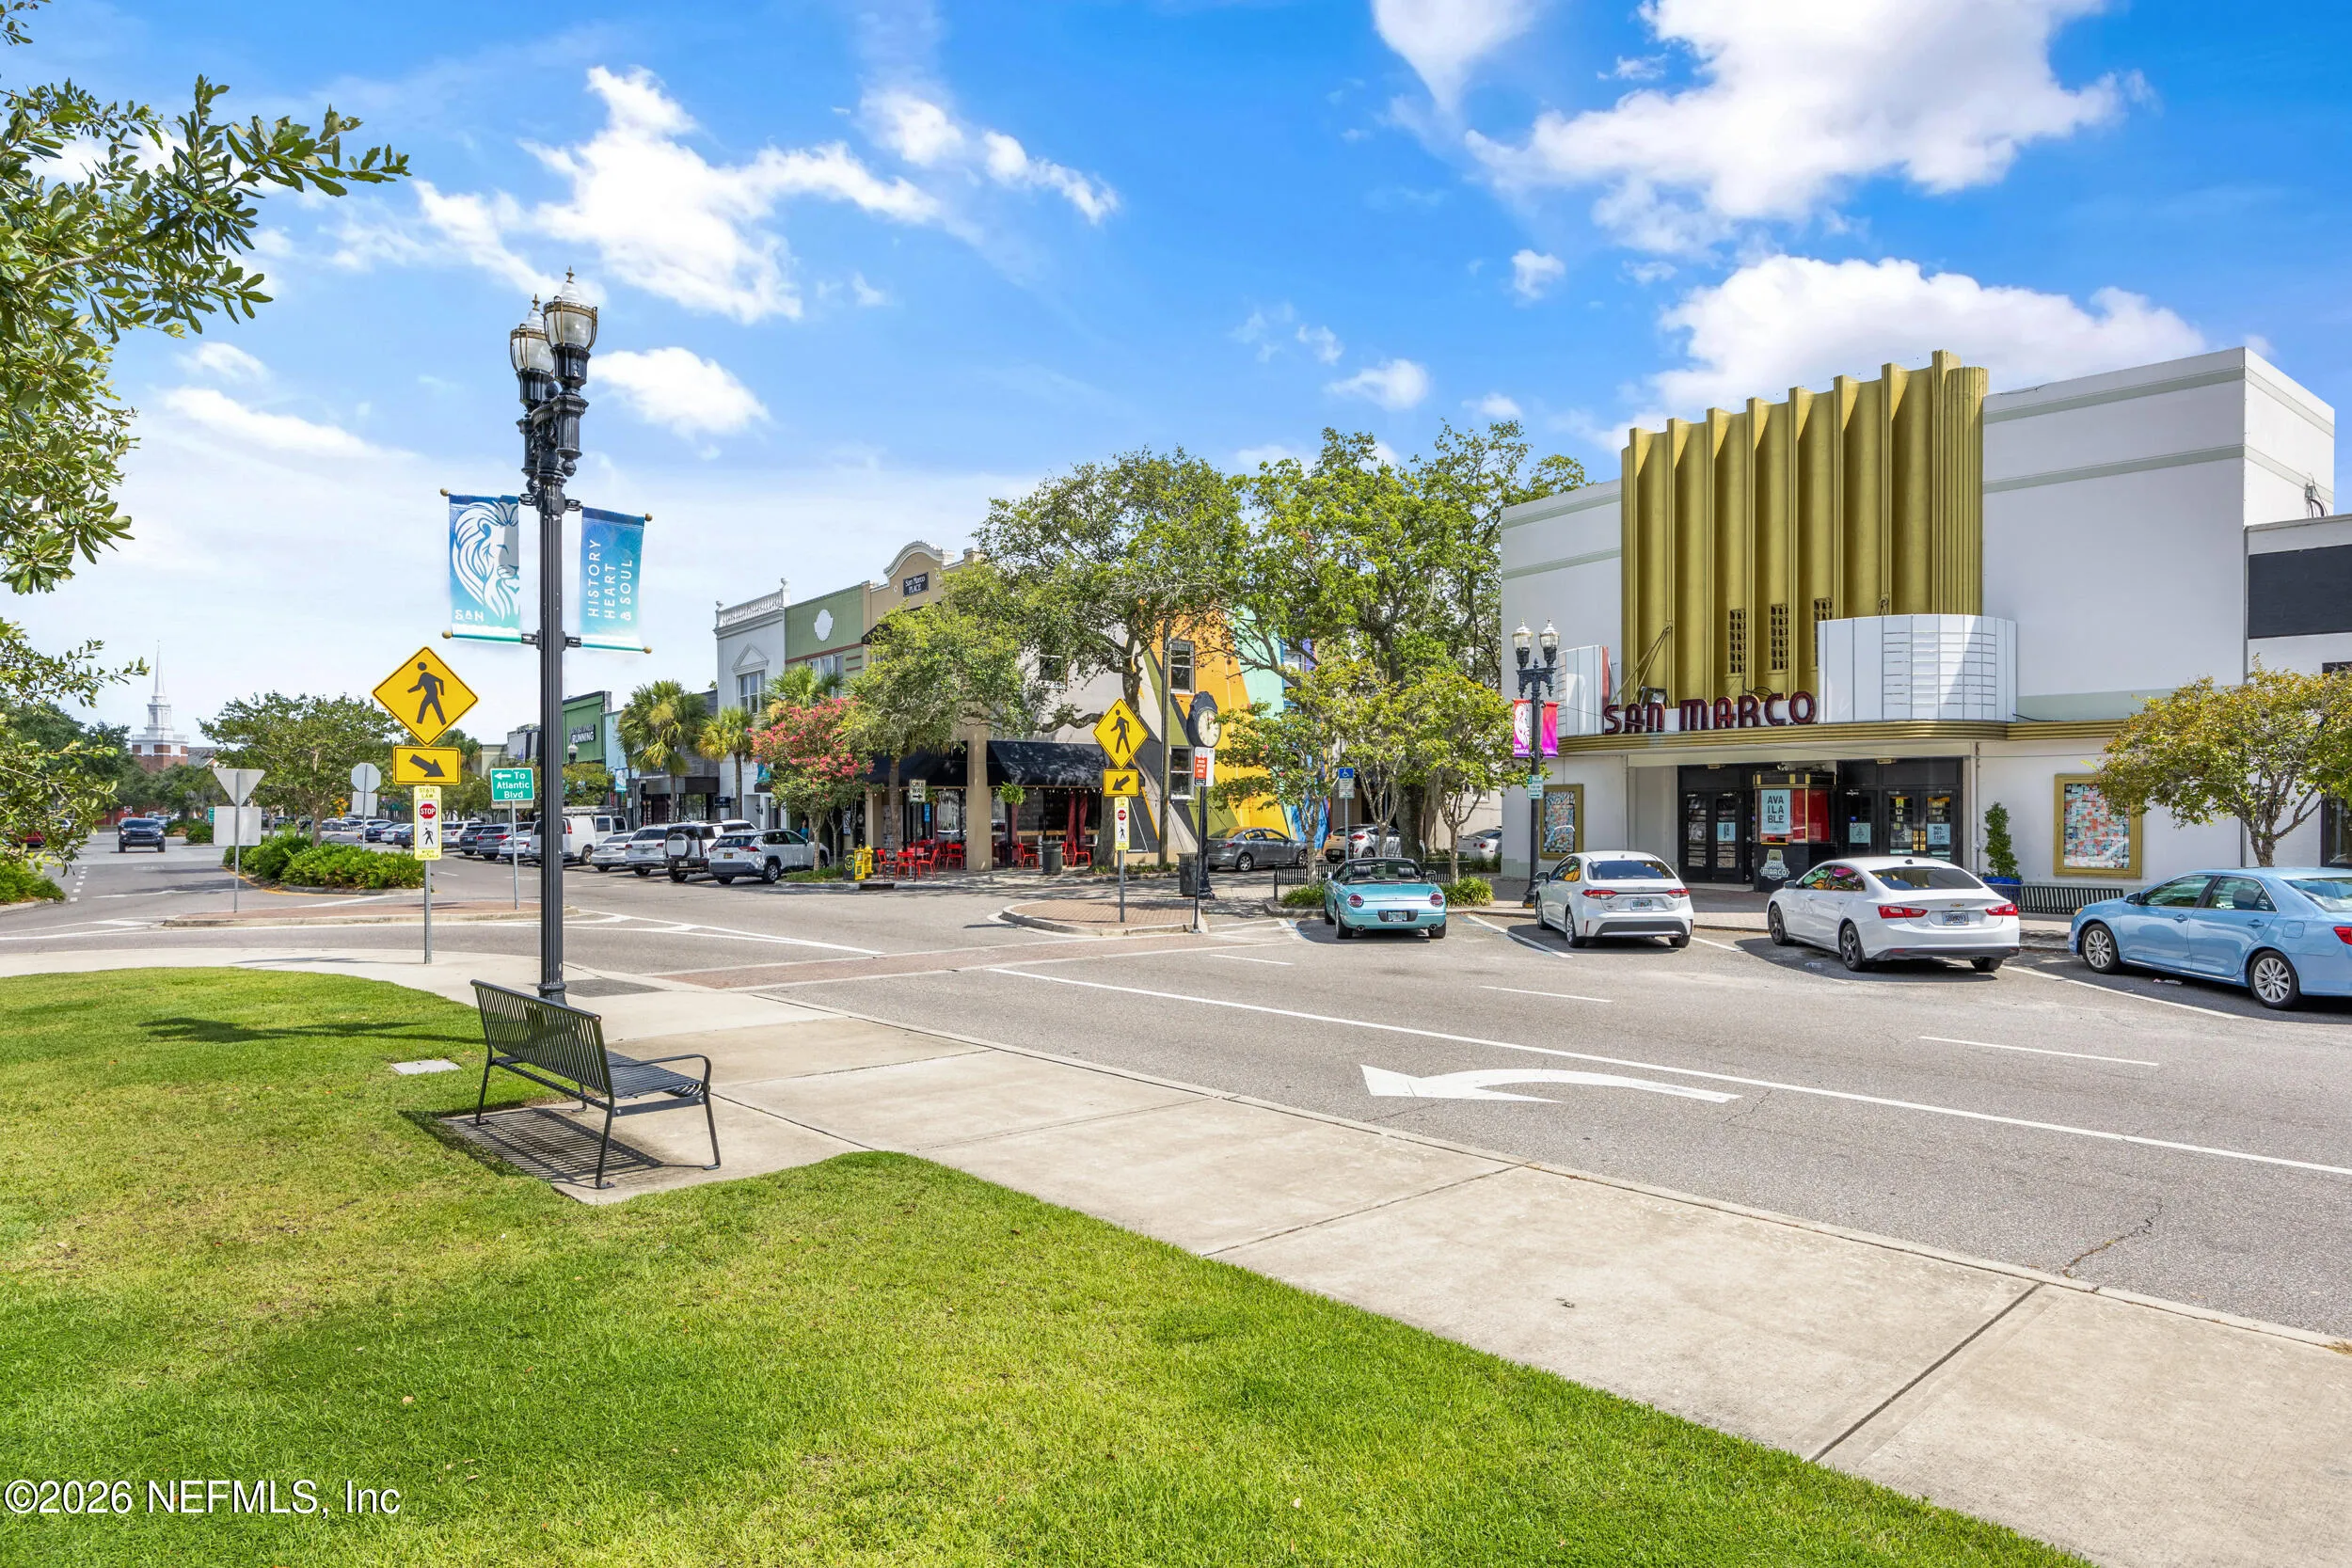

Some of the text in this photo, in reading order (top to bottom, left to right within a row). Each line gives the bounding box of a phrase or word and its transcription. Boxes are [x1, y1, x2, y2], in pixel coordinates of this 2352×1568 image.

[587, 539, 601, 618] HISTORY
[603, 562, 616, 620] HEART
[619, 560, 633, 622] & SOUL
[454, 609, 485, 622] SAN
[1603, 690, 1818, 736] SAN MARCO
[571, 731, 595, 744] RUNNING
[514, 771, 526, 780] To
[496, 781, 531, 790] Atlantic
[503, 790, 524, 799] Blvd
